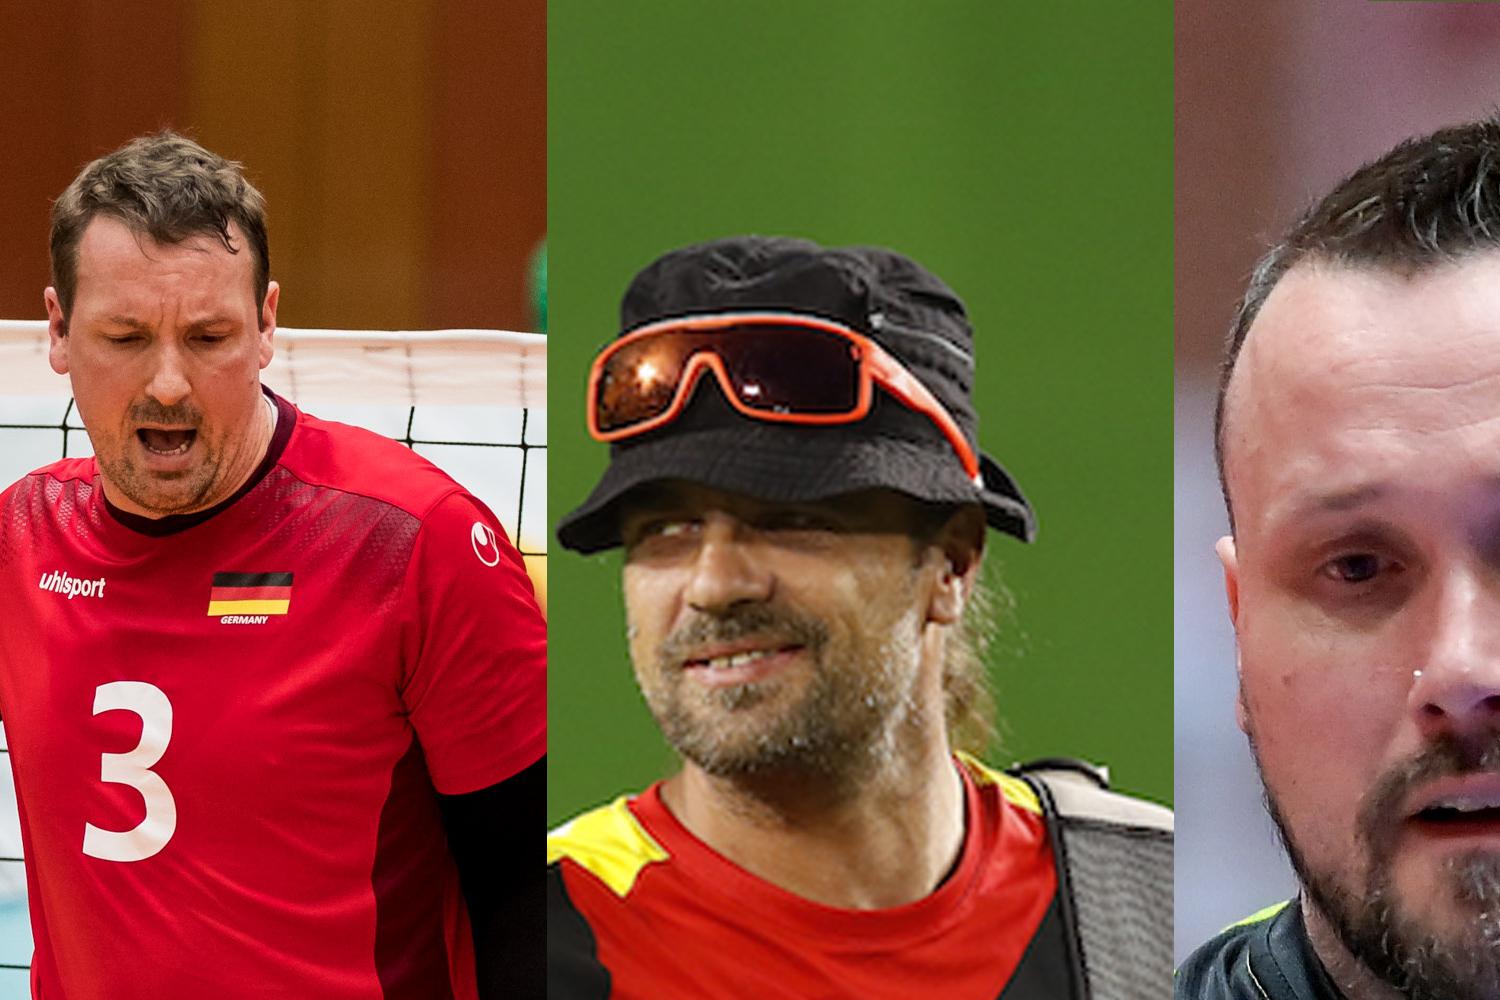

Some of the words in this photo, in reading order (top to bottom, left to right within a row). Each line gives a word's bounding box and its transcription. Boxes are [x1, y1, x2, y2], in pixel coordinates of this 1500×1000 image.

[39, 570, 106, 599] uhlsport
[220, 615, 268, 625] GERMANY
[82, 681, 178, 863] 3
